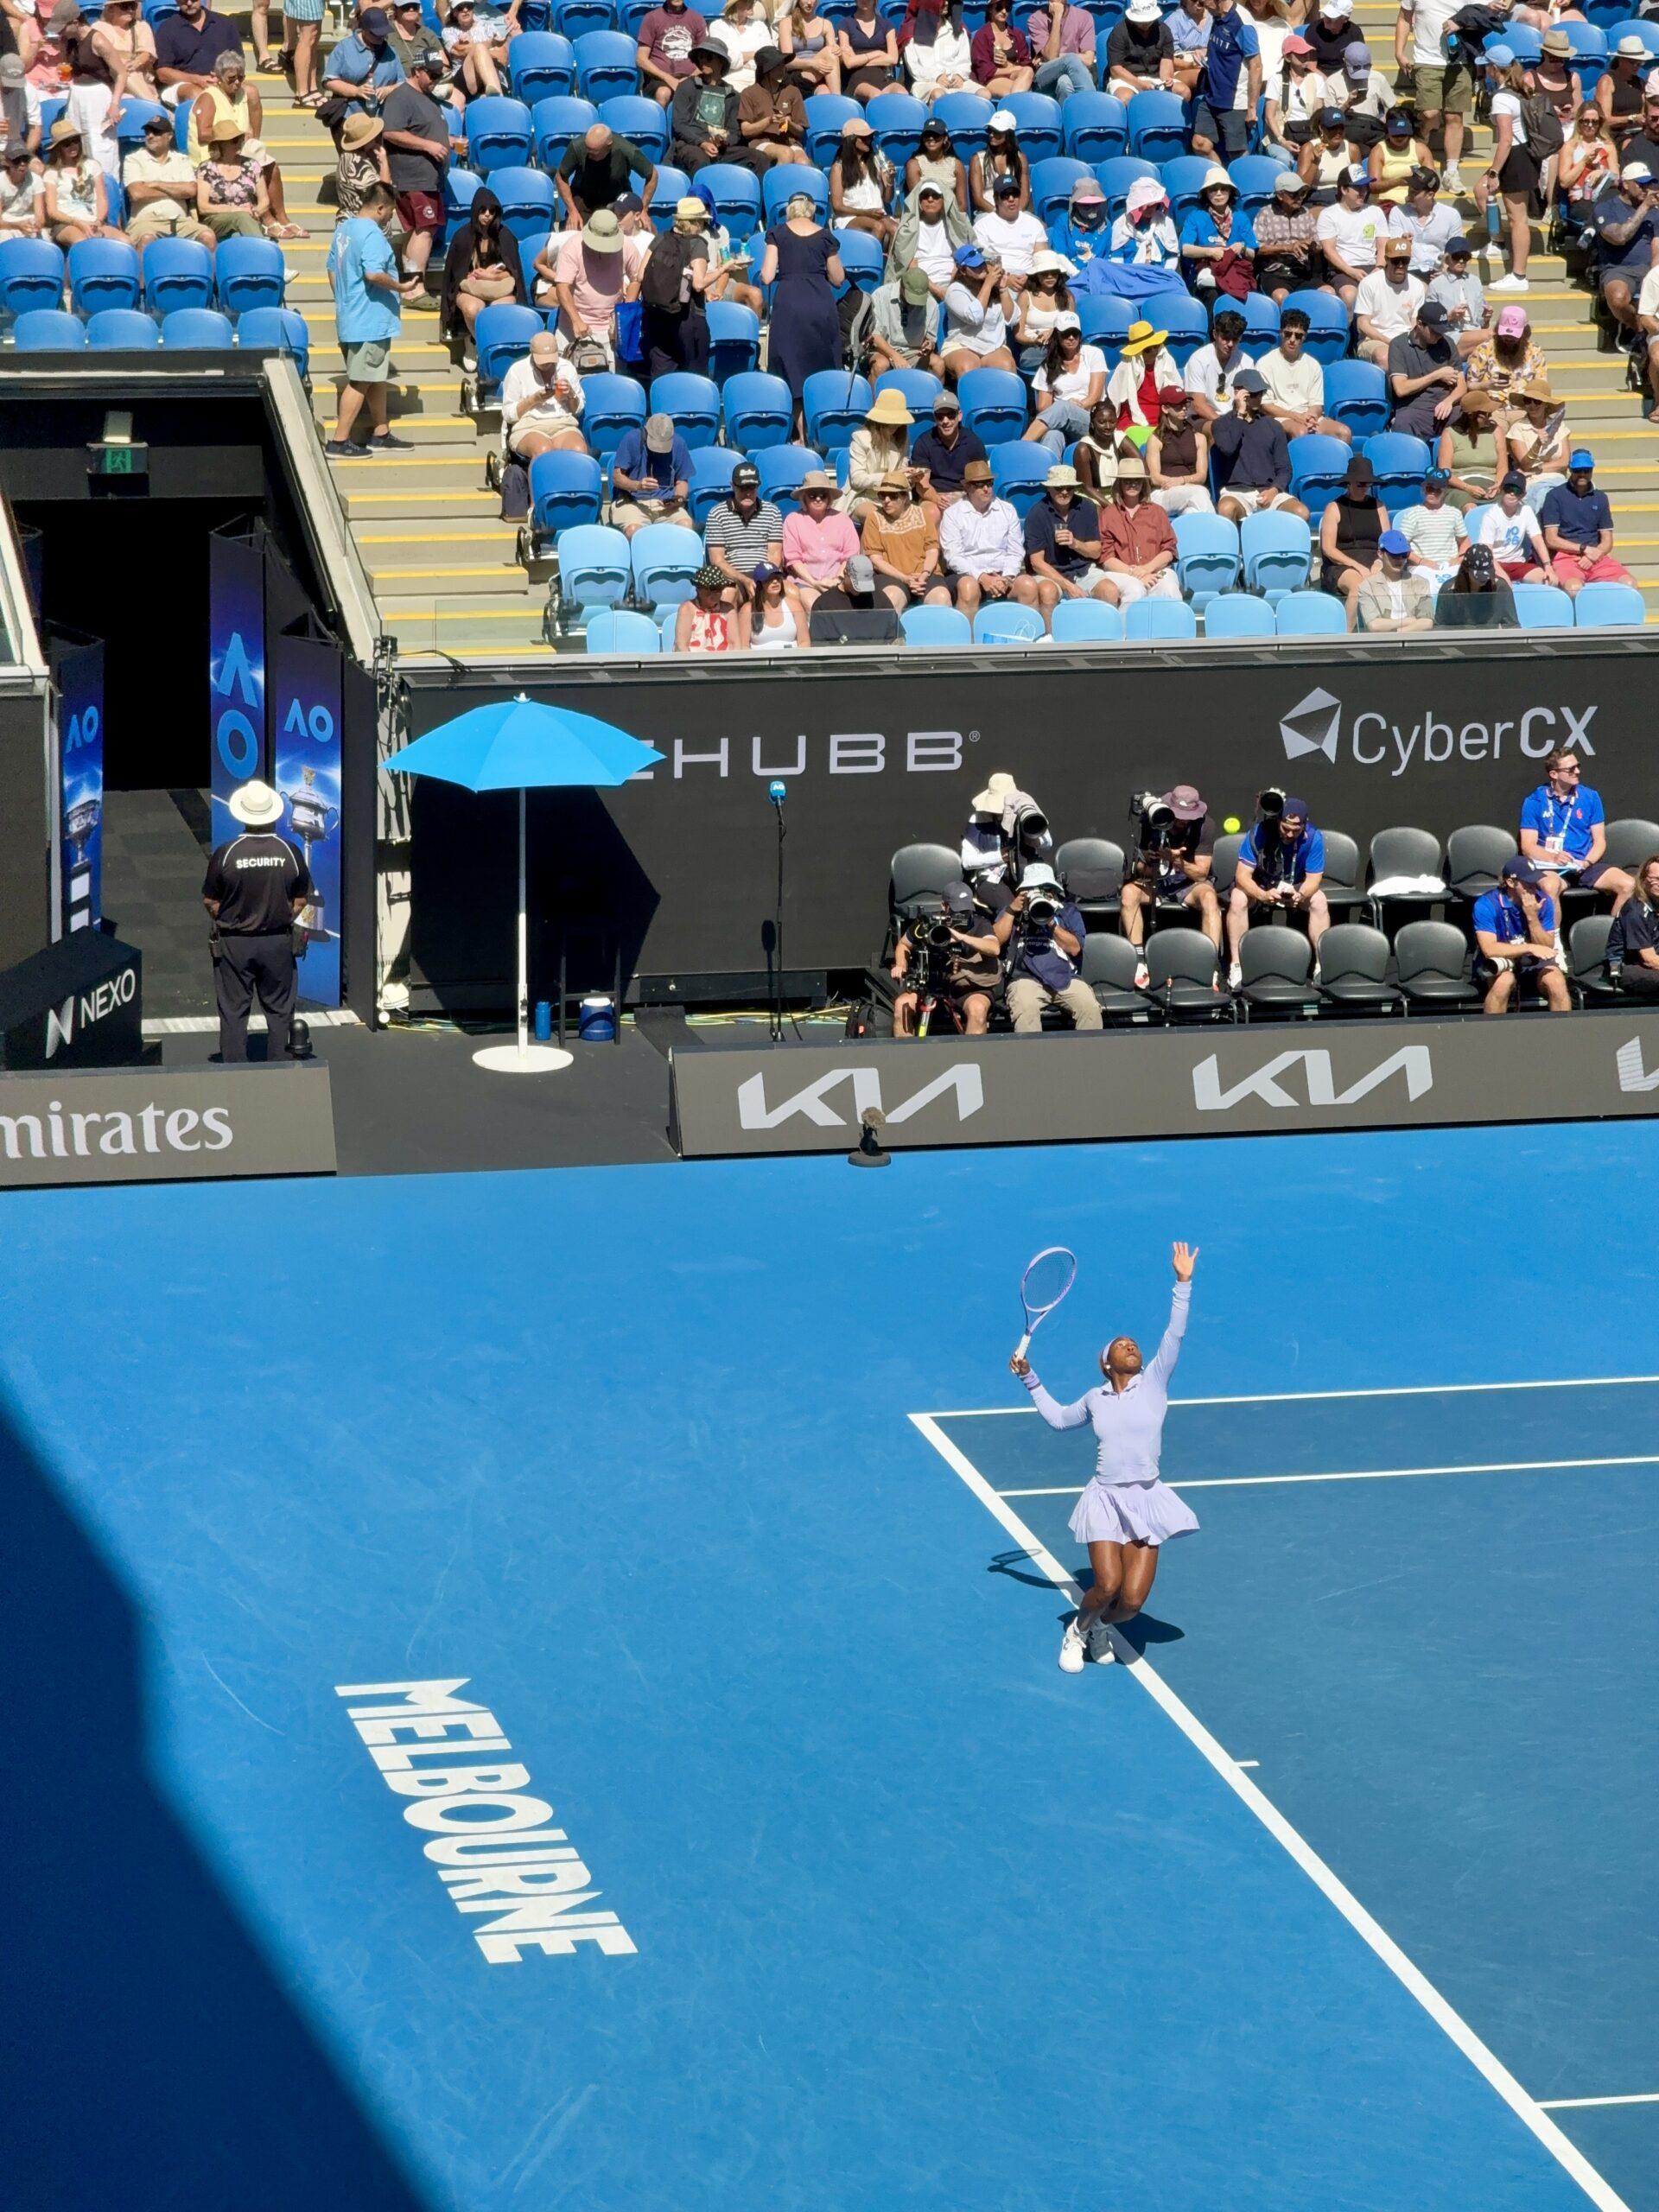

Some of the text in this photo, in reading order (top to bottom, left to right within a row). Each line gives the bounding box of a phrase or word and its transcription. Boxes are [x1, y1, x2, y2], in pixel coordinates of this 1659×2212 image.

[1395, 243, 1407, 251] AO
[1503, 317, 1519, 327] AO
[66, 706, 99, 753] AO
[283, 698, 334, 742] AO
[1352, 705, 1599, 777] CyberCX
[236, 855, 286, 869] SECURITY
[80, 968, 137, 1029] NEXO
[1192, 1046, 1433, 1110] KIA
[0, 1100, 233, 1159] mirates
[334, 1677, 639, 1964] MELBOURNE
